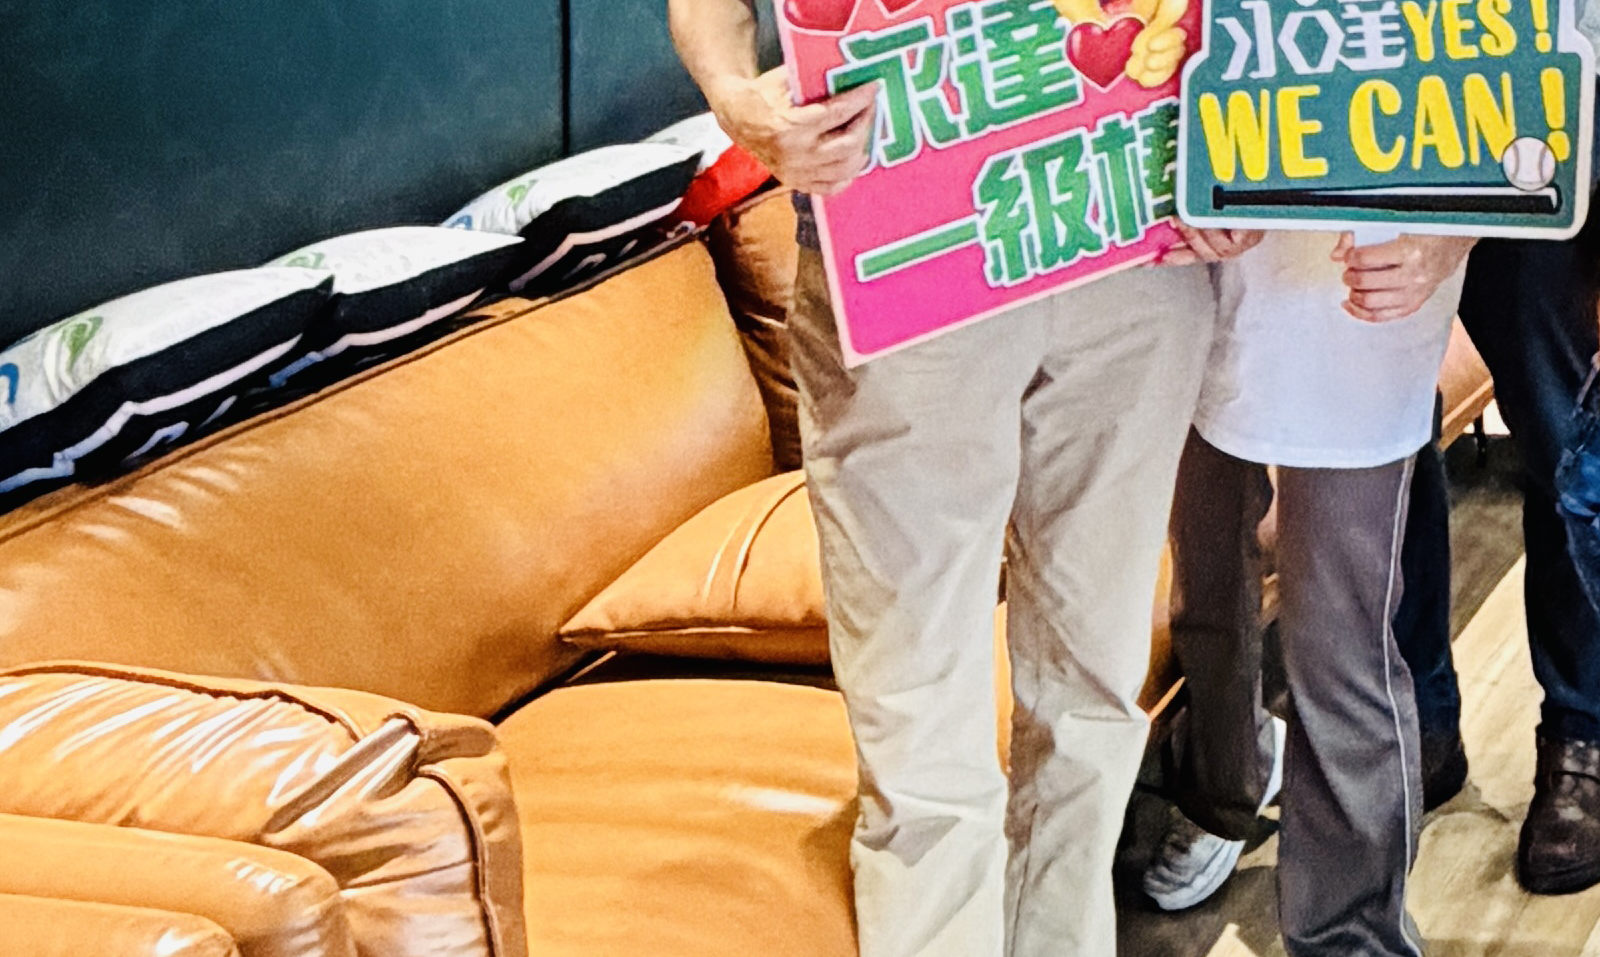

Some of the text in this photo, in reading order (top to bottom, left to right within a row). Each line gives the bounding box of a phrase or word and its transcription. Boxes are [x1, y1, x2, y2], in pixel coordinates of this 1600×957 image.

[859, 102, 1181, 283] 一級棒
[1199, 84, 1329, 183] WE
